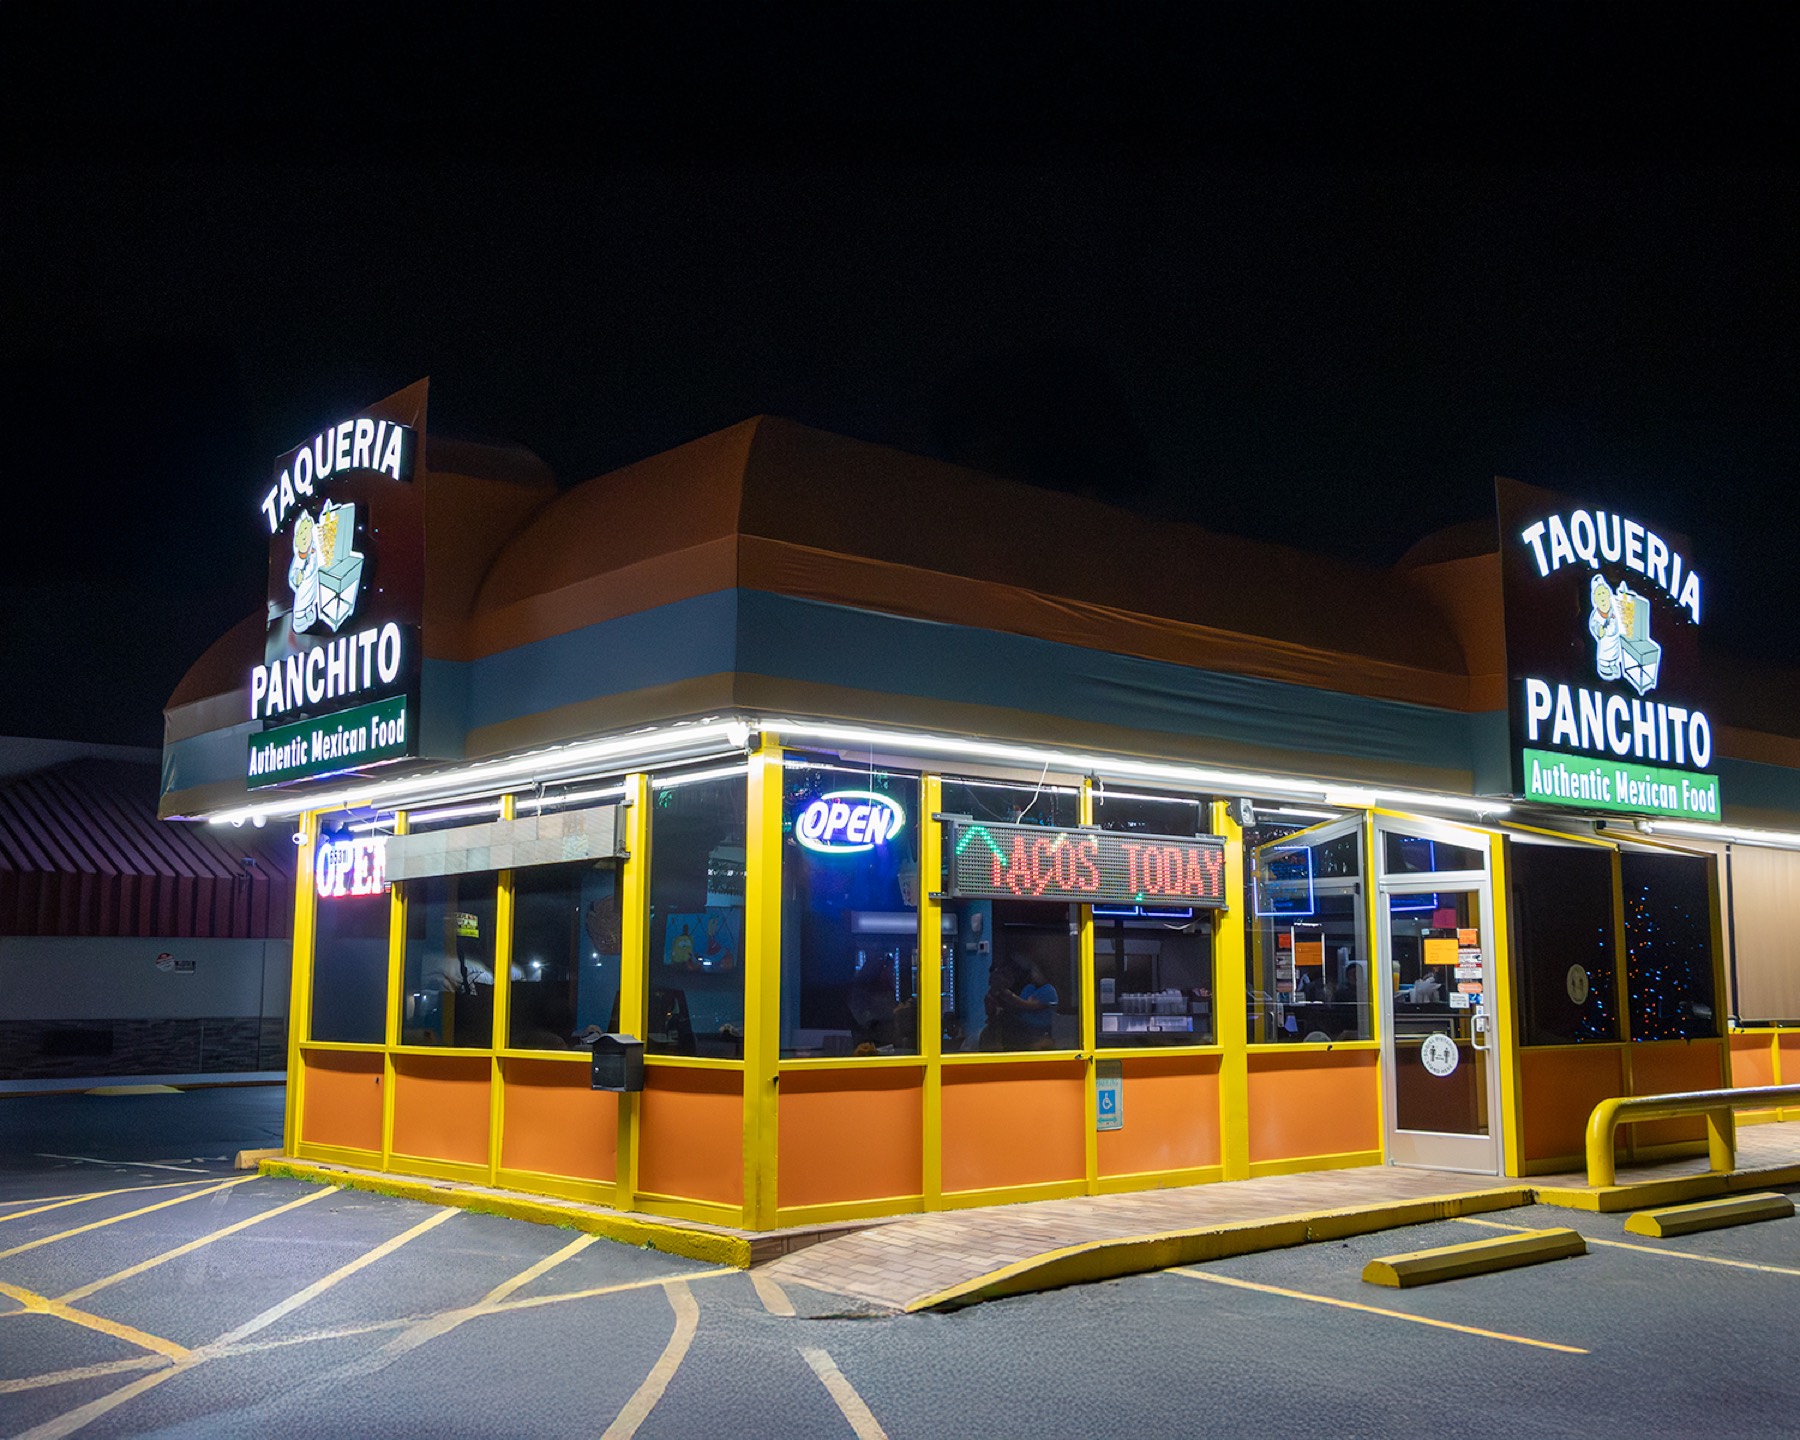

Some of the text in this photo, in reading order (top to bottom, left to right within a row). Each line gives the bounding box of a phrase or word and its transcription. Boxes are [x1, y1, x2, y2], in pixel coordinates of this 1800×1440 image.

[262, 418, 403, 535] TAQUERIA
[1522, 509, 1701, 625] TAQUERIA
[251, 622, 401, 720] PANCHITO
[248, 709, 405, 776] Authentic Mexican Food
[1525, 677, 1711, 769] PANCHITO
[803, 801, 891, 845] OPEN
[1531, 759, 1716, 814] Authentic Mexican Food
[1121, 843, 1223, 897] TODAY
